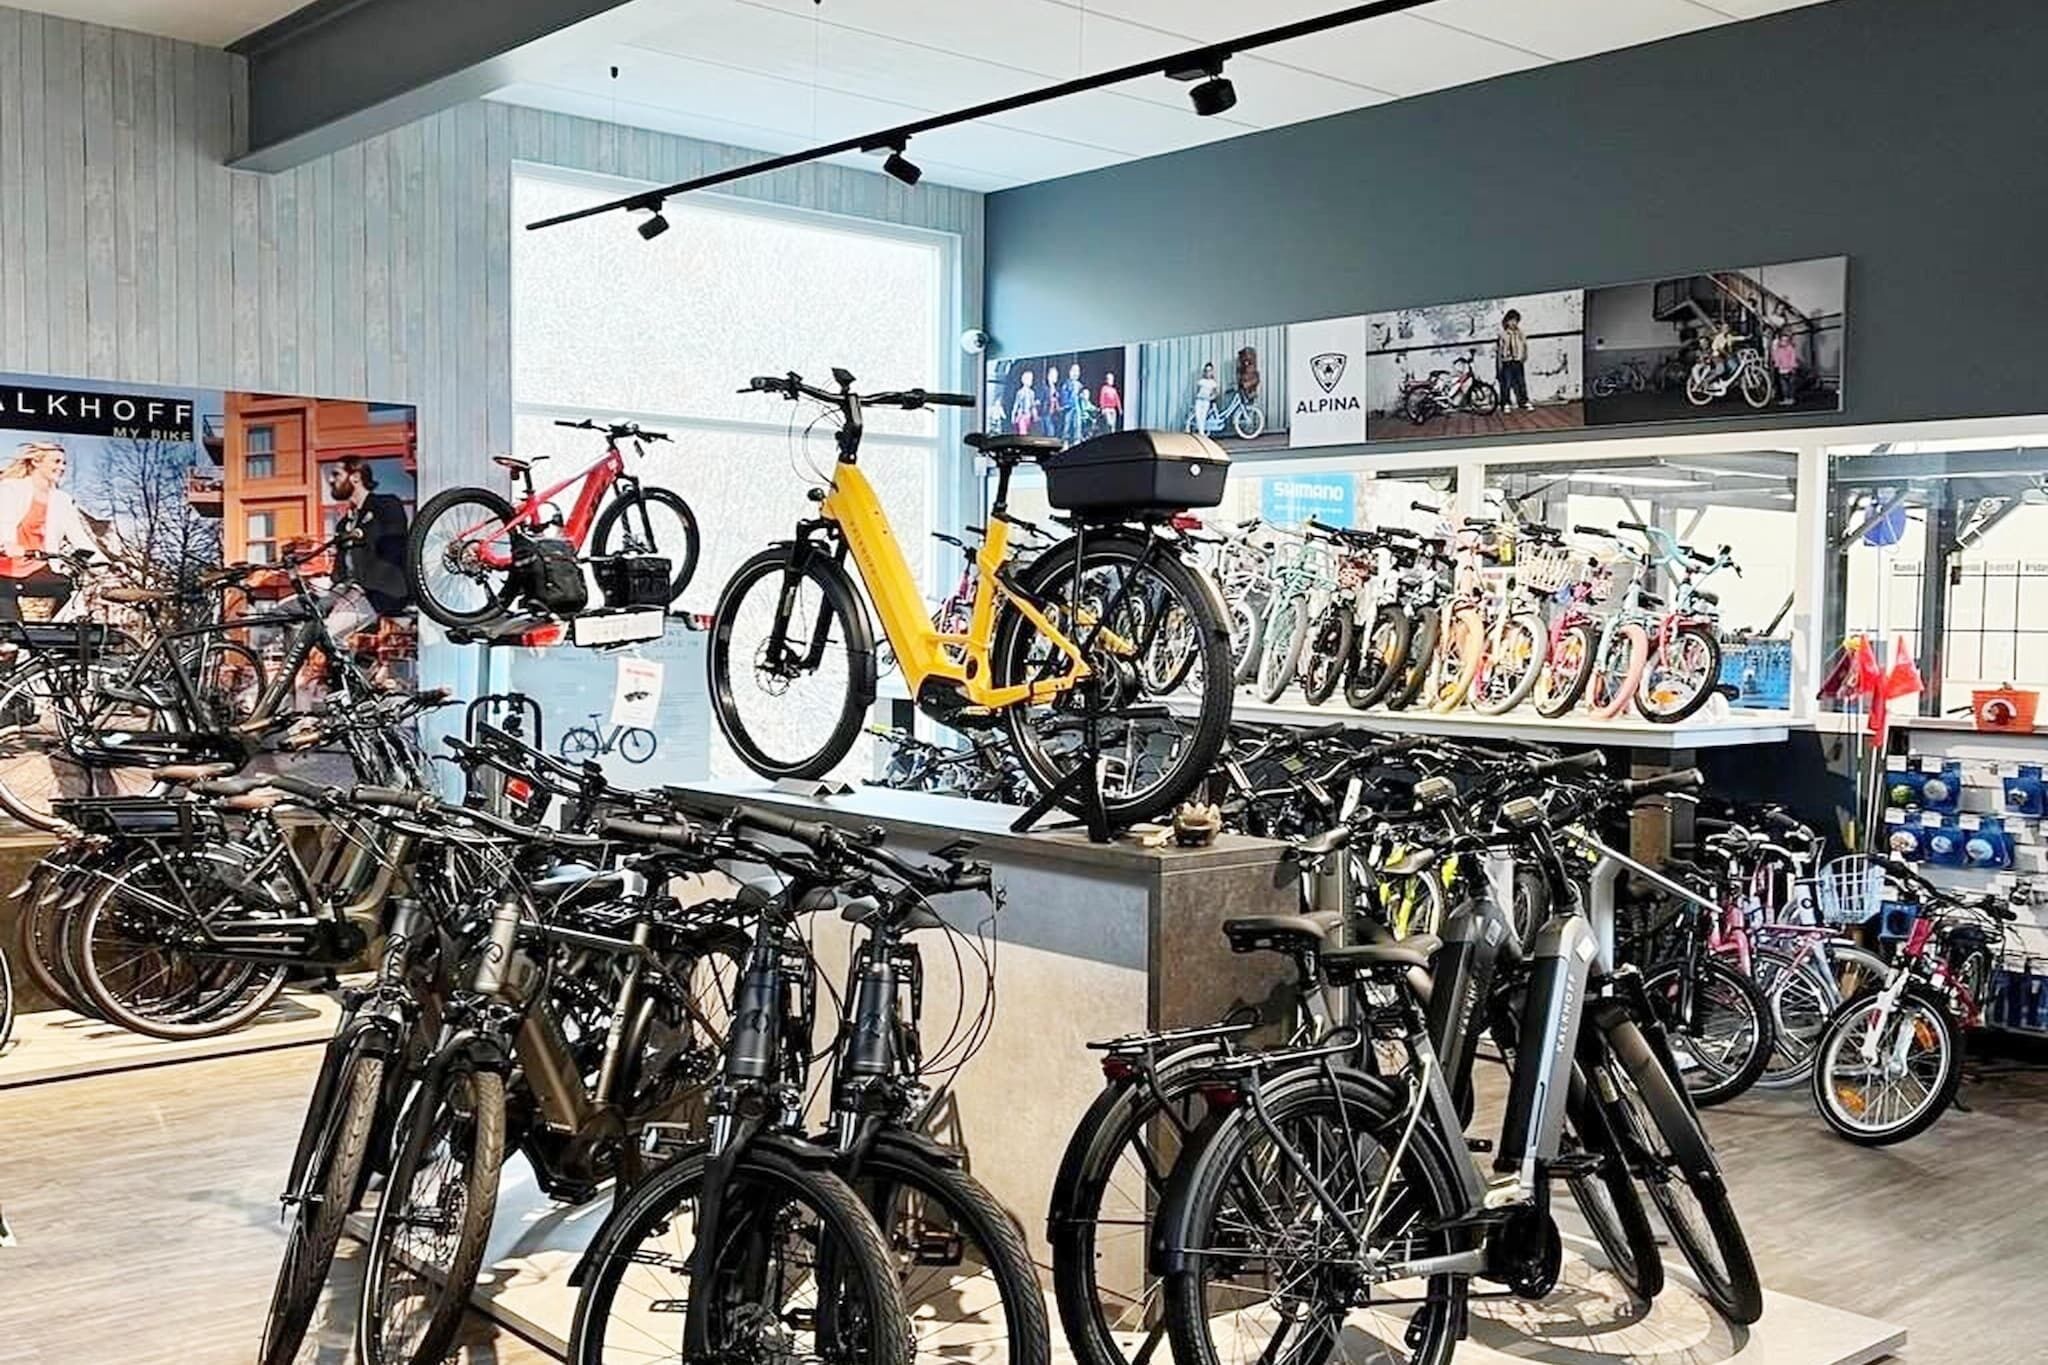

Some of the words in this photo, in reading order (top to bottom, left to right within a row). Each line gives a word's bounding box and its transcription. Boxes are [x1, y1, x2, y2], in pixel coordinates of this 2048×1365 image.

[0, 392, 191, 424] LKHOFF
[1295, 396, 1360, 414] ALPINA
[113, 427, 140, 439] MY
[150, 429, 192, 442] BIKE
[1556, 973, 1577, 1053] KALKHOFF
